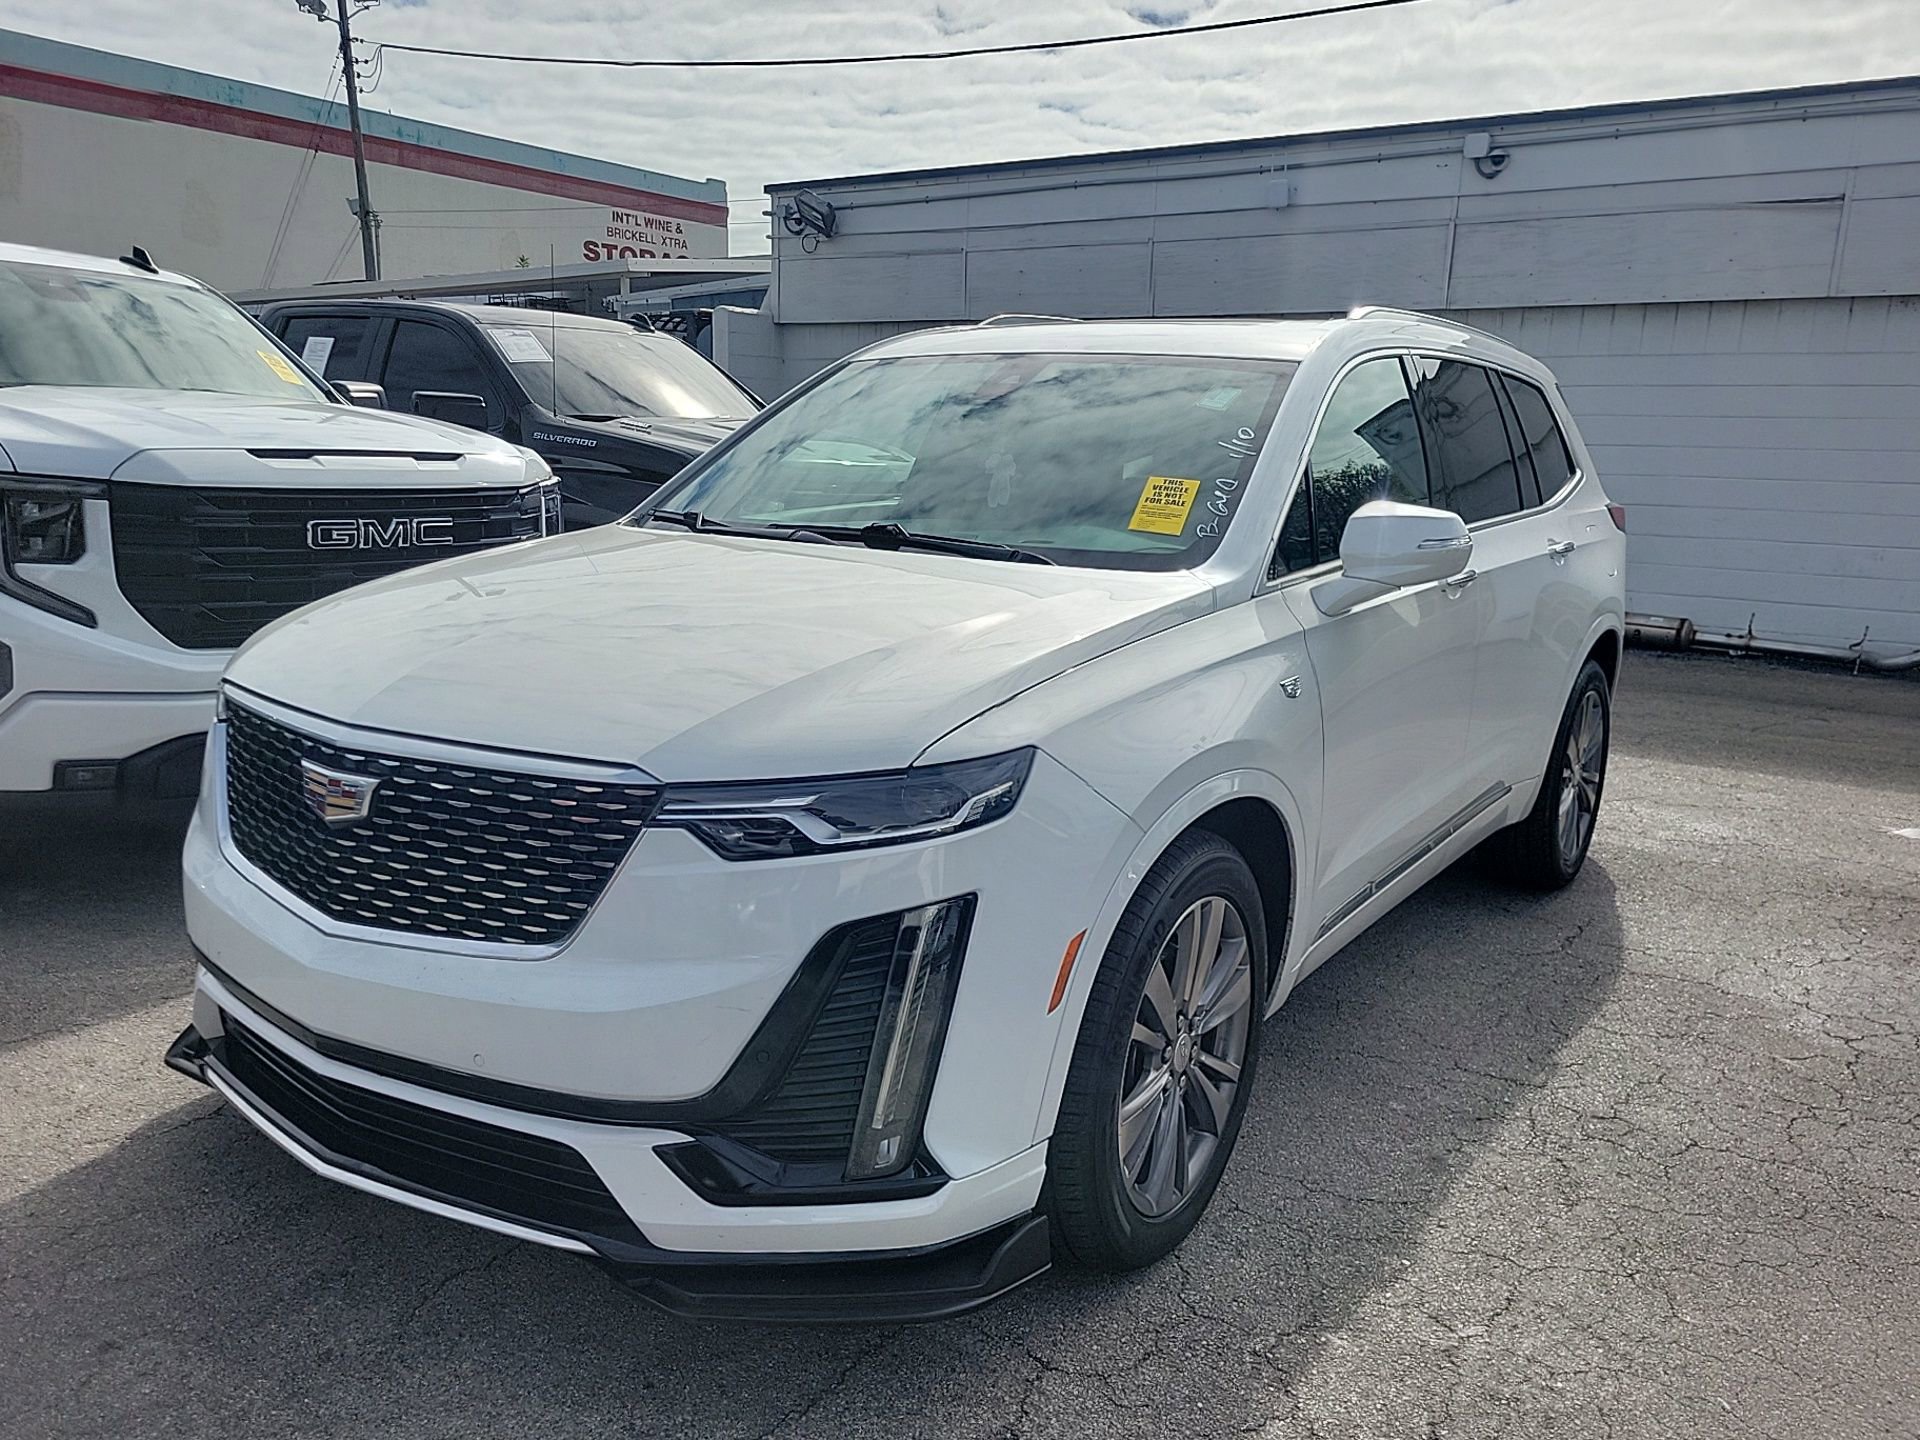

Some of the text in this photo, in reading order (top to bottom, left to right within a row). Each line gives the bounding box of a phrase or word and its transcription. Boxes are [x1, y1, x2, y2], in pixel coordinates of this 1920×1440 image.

[644, 217, 672, 233] WINE
[675, 223, 683, 234] &
[607, 227, 688, 250] BRICKELL XTRA
[533, 432, 597, 447] SILVERADO
[1163, 479, 1185, 487] THIS
[1153, 485, 1190, 494] VEHICLE
[1144, 497, 1187, 507] FOR SALE
[1164, 492, 1184, 500] NOT
[307, 517, 453, 549] GMC
